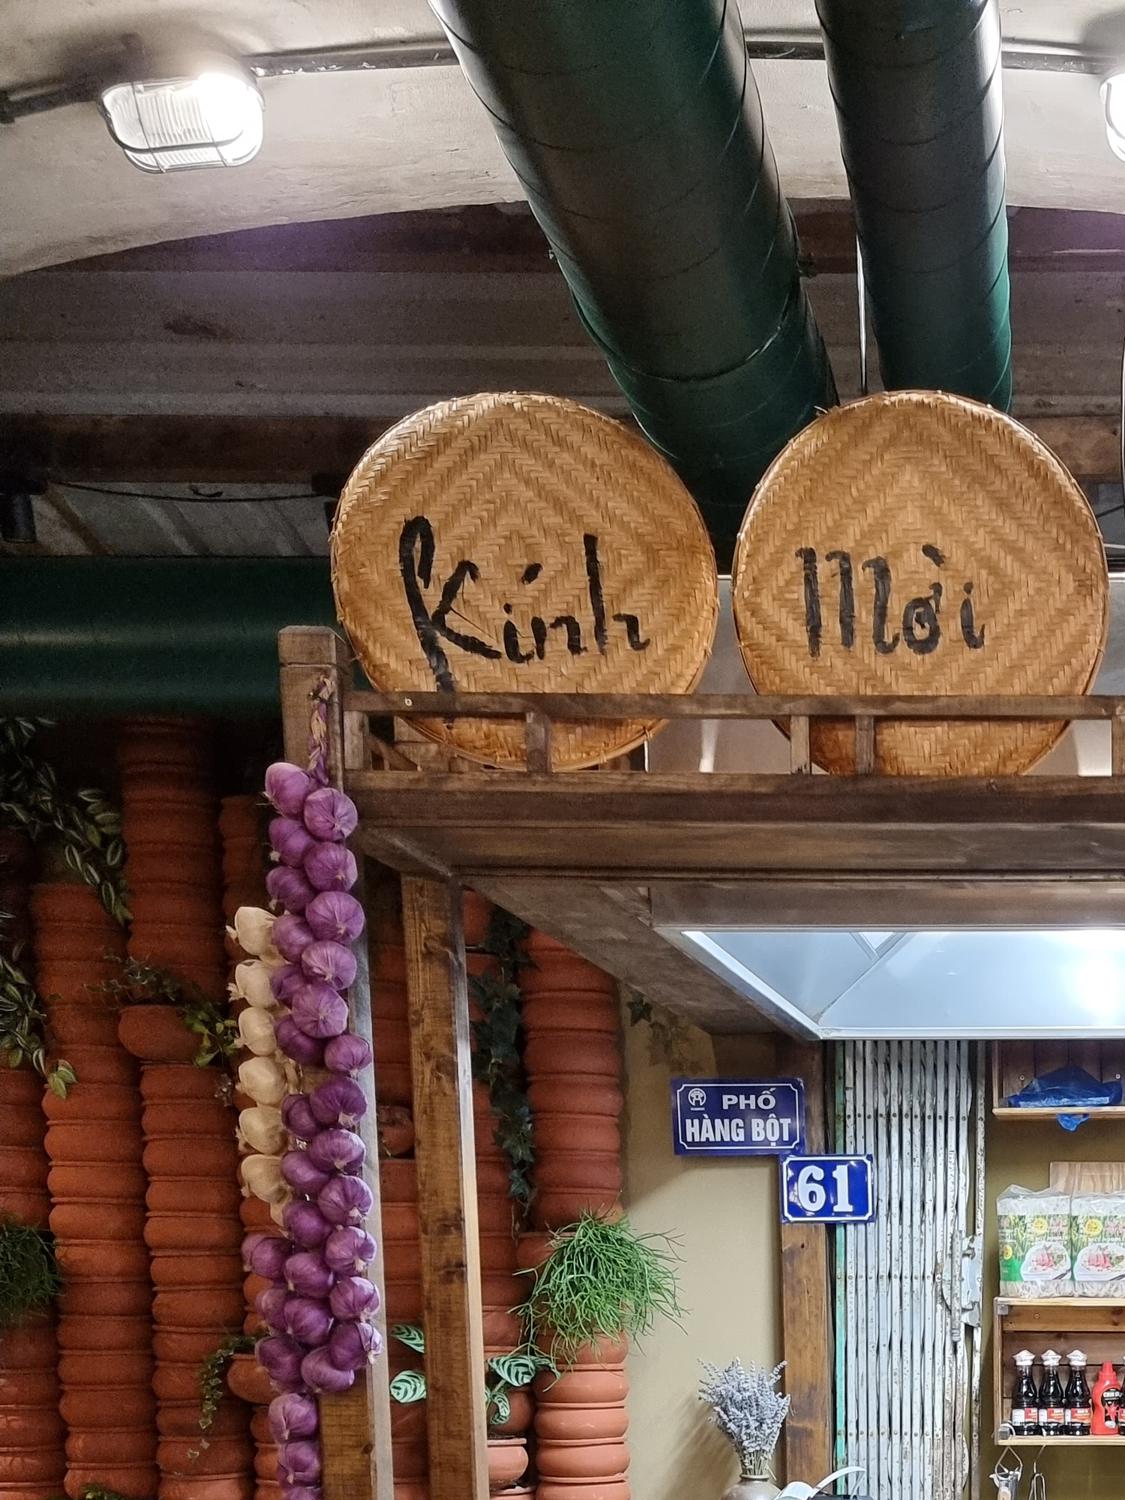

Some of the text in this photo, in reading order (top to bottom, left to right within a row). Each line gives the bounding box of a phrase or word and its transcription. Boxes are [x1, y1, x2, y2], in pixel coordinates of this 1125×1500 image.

[797, 544, 986, 660] Mời
[722, 1087, 776, 1110] PHỐ
[686, 1114, 791, 1146] HÀNG BỘT
[797, 1164, 853, 1213] 61
